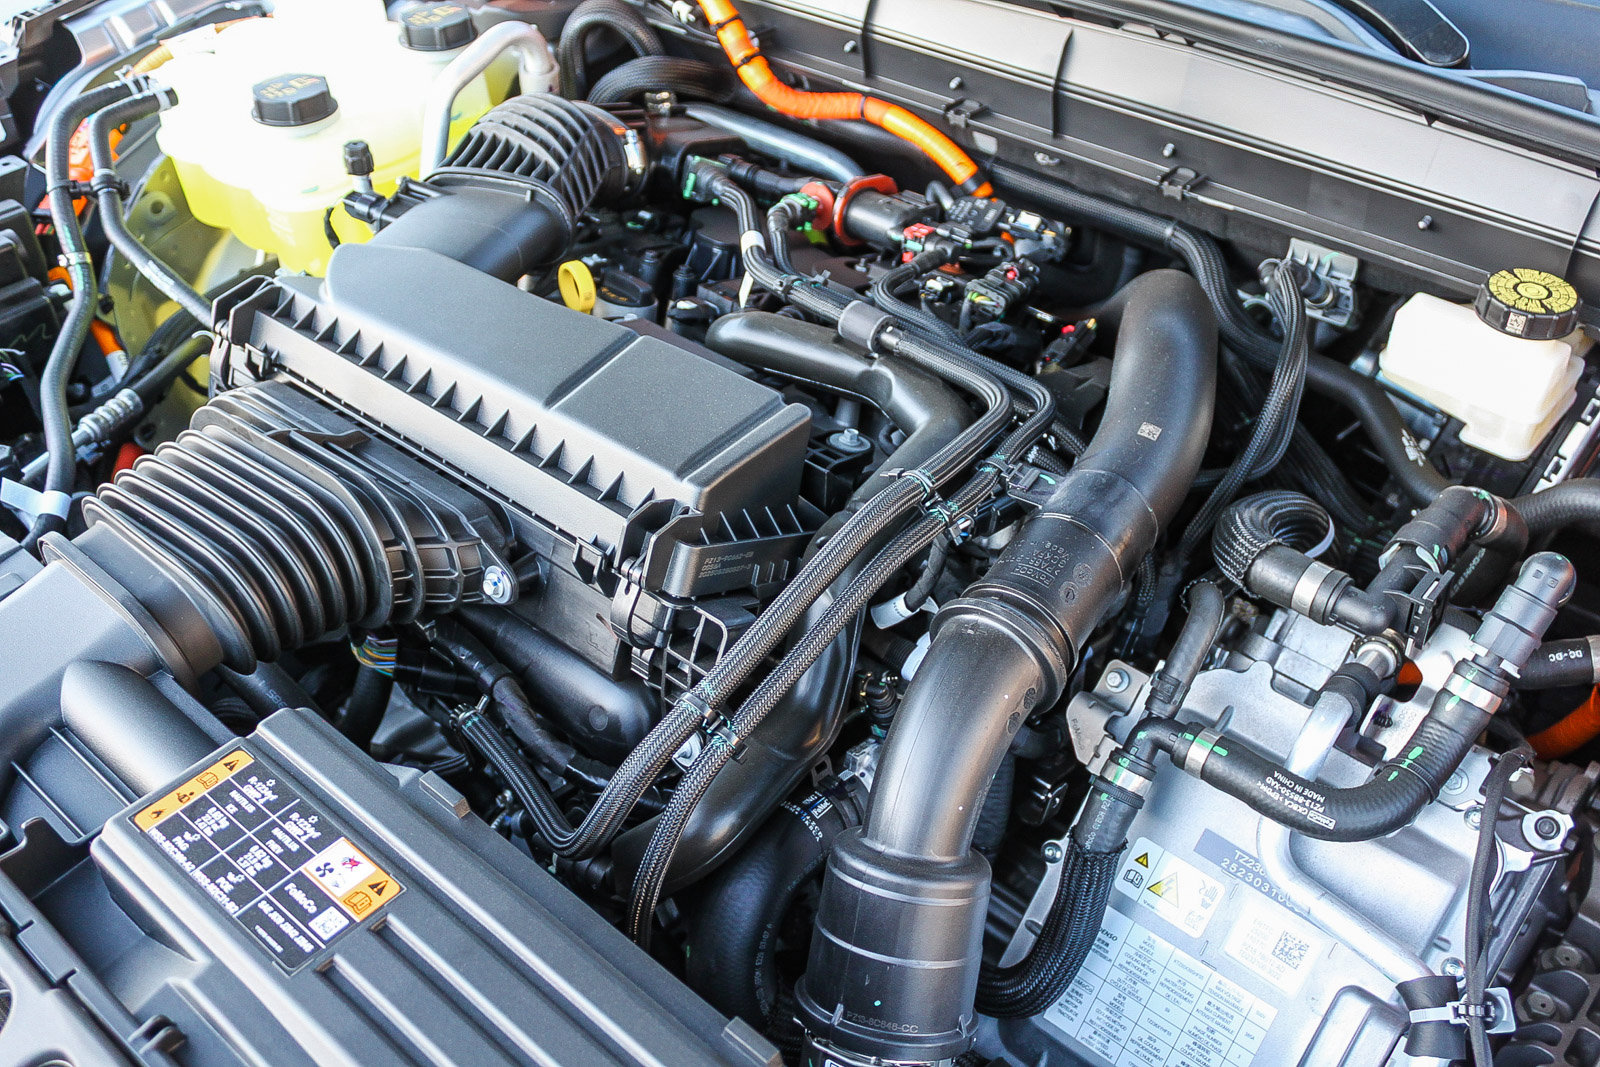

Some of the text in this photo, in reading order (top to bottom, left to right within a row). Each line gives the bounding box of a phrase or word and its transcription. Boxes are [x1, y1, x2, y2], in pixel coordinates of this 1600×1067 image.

[1547, 649, 1583, 662] DC-DC
[1271, 770, 1325, 803] MADE IN CHINA
[171, 835, 191, 851] PAG
[282, 881, 320, 914] FoMoCo
